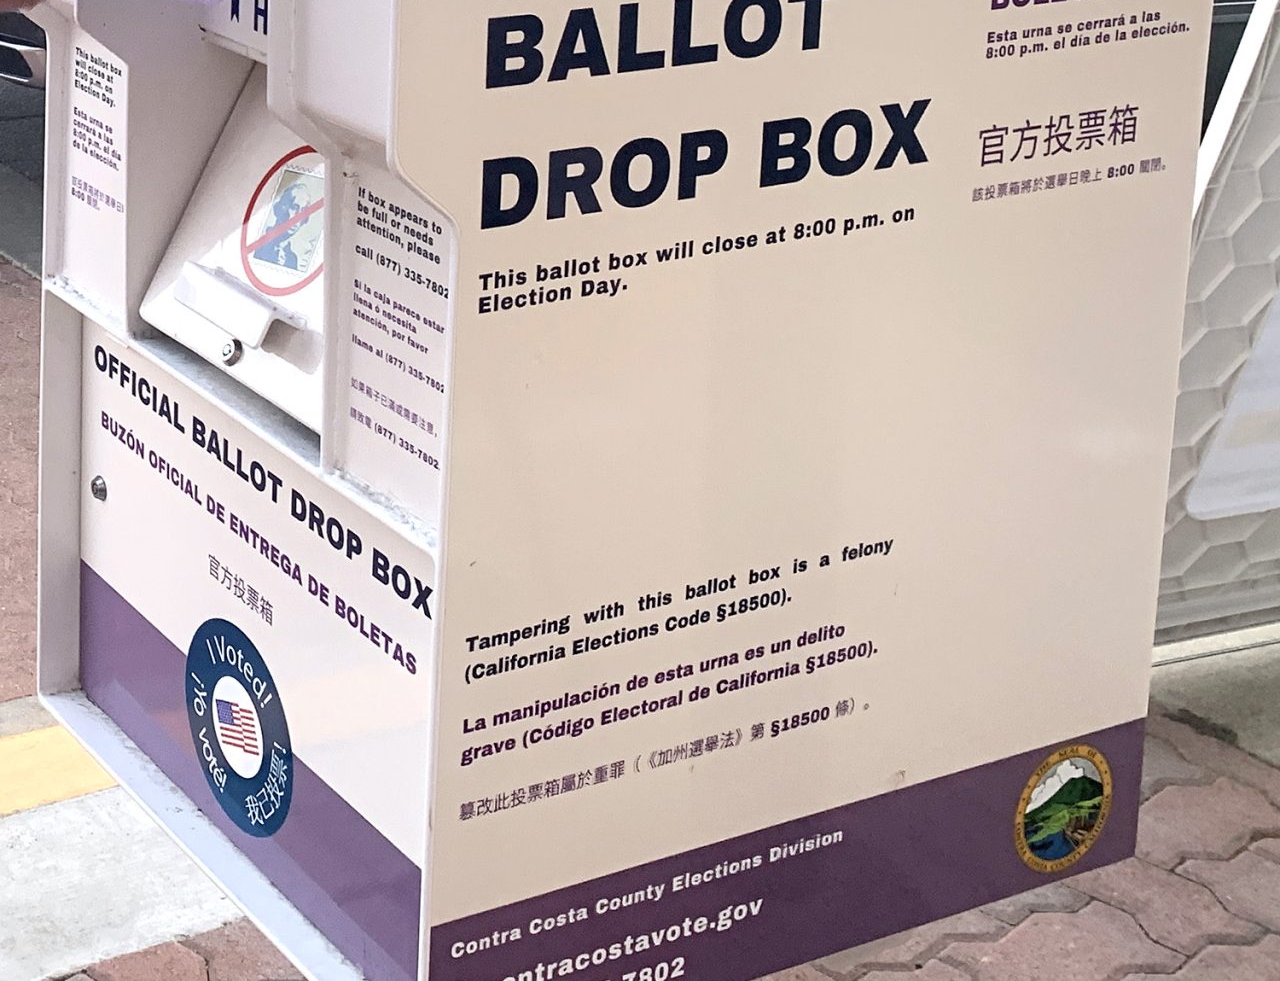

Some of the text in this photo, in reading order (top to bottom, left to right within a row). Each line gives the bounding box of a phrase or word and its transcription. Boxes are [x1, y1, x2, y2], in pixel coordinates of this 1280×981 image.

[985, 21, 1189, 59] 8:00 p.m. el día de la elección.
[987, 11, 1160, 43] Esta urna se cerrará a las
[480, 98, 931, 230] DROP BOX
[979, 104, 1139, 167] 官方投票箱
[1107, 163, 1135, 178] 8:00
[356, 216, 440, 264] attention, please
[357, 200, 433, 246] be full or needs
[358, 186, 442, 235] If box appears to
[355, 244, 373, 260] call
[376, 252, 401, 275] (877)
[478, 208, 914, 290] This ballot box will close at 8:00 p.m. on
[478, 278, 627, 314] Election Day.
[374, 422, 396, 444] (877)
[94, 344, 433, 620] OFFICIAL BALLOT DROP BOX
[101, 410, 416, 675] BUZÓN OFICIAL DE ENTREGA DE BOLETAS
[208, 554, 273, 626] 官方投票箱
[465, 539, 893, 652] Tampering with this ballot box is a felony
[206, 635, 273, 709] I Voted!
[464, 588, 791, 684] (California Elections Code §18500).
[460, 640, 877, 766] grave (Código Electoral de California §18500).
[463, 624, 845, 734] La manipulación de esta urna es un delito
[191, 672, 228, 794] ¡Yo voté!
[770, 706, 831, 737] §18500
[451, 830, 843, 958] Contra Costa County Elections Division
[504, 898, 763, 981] ntracostavote.gov
